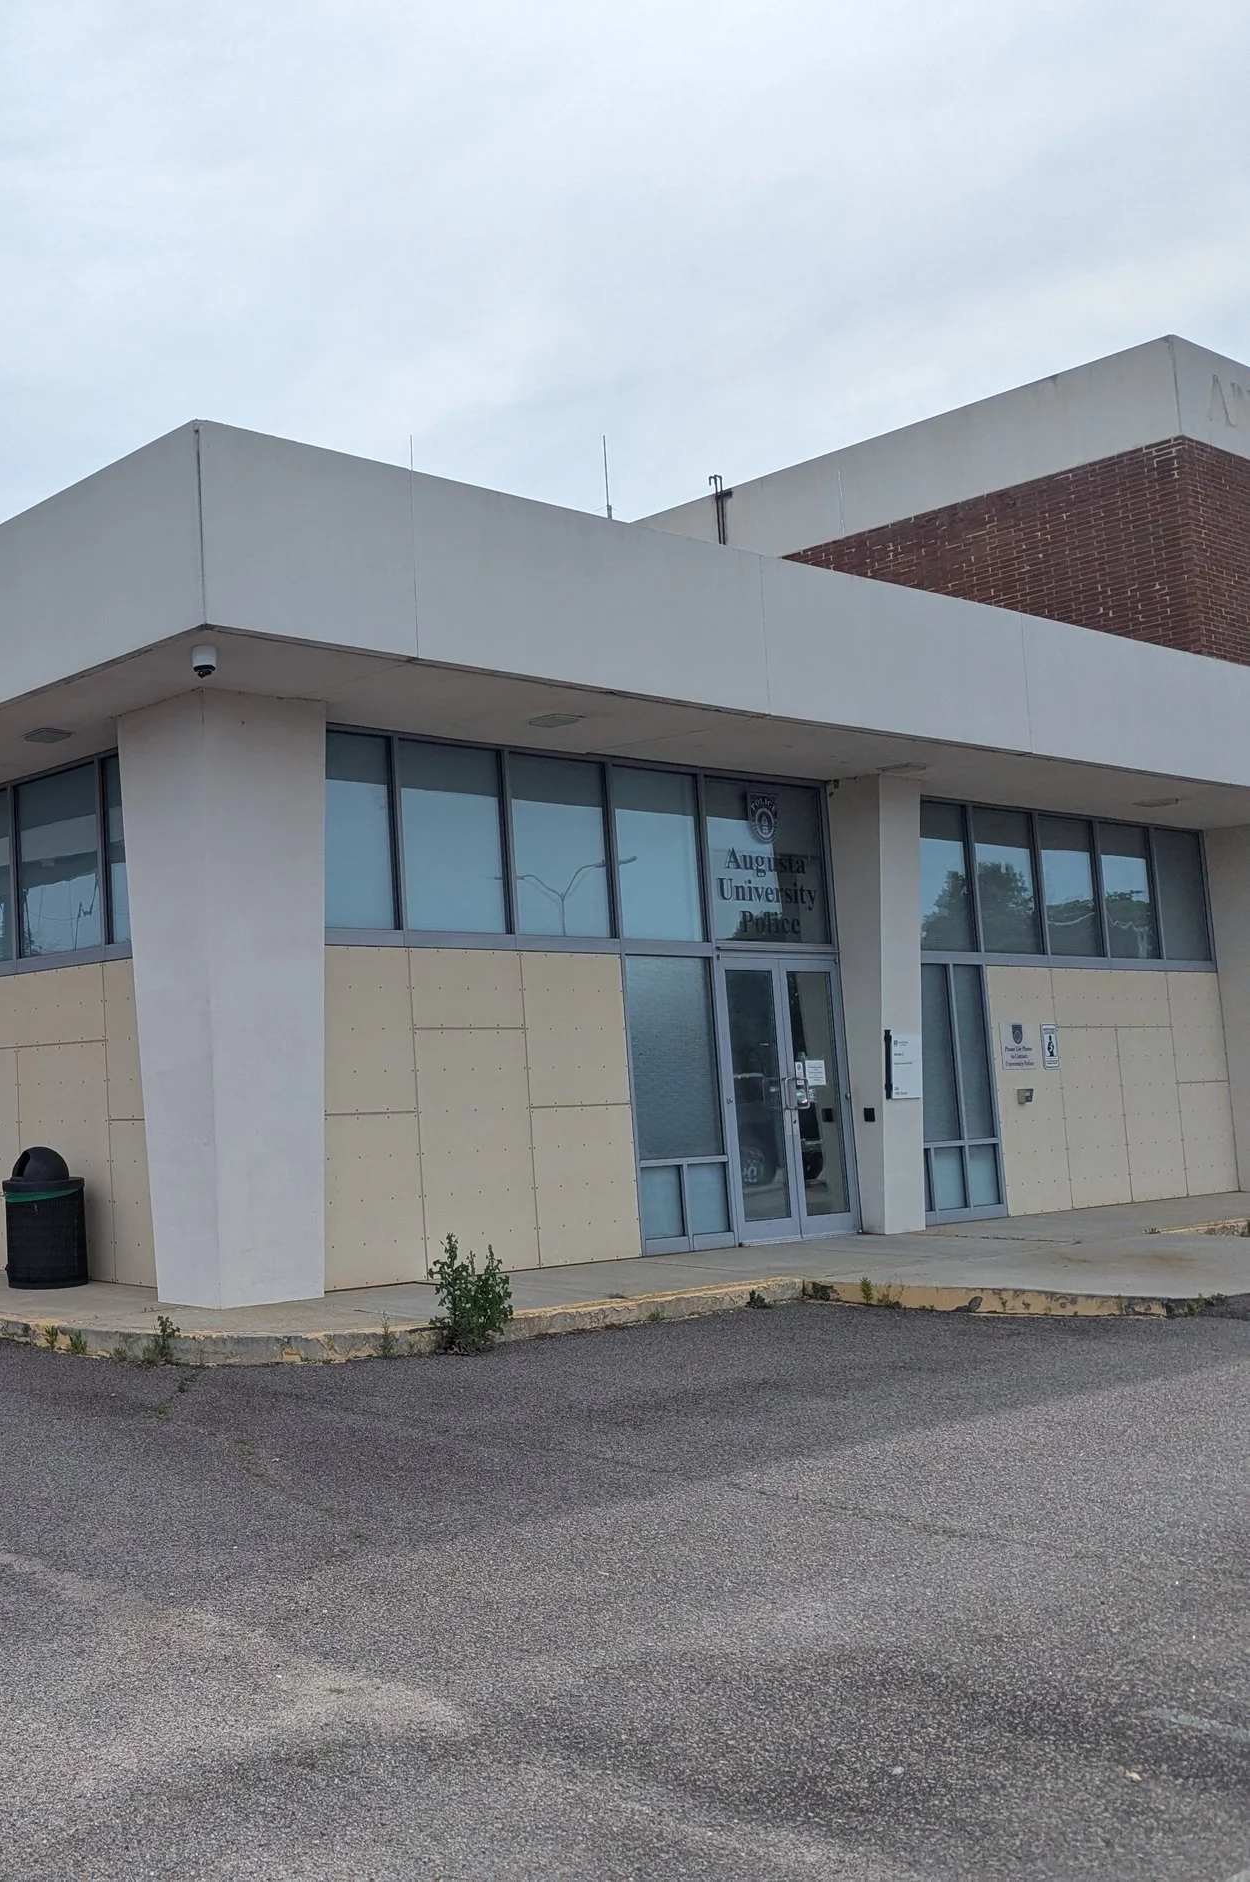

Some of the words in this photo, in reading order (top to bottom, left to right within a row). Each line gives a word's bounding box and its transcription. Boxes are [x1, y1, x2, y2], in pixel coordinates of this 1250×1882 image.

[725, 848, 806, 877] Augusta
[717, 877, 818, 910] University
[740, 910, 802, 935] Police
